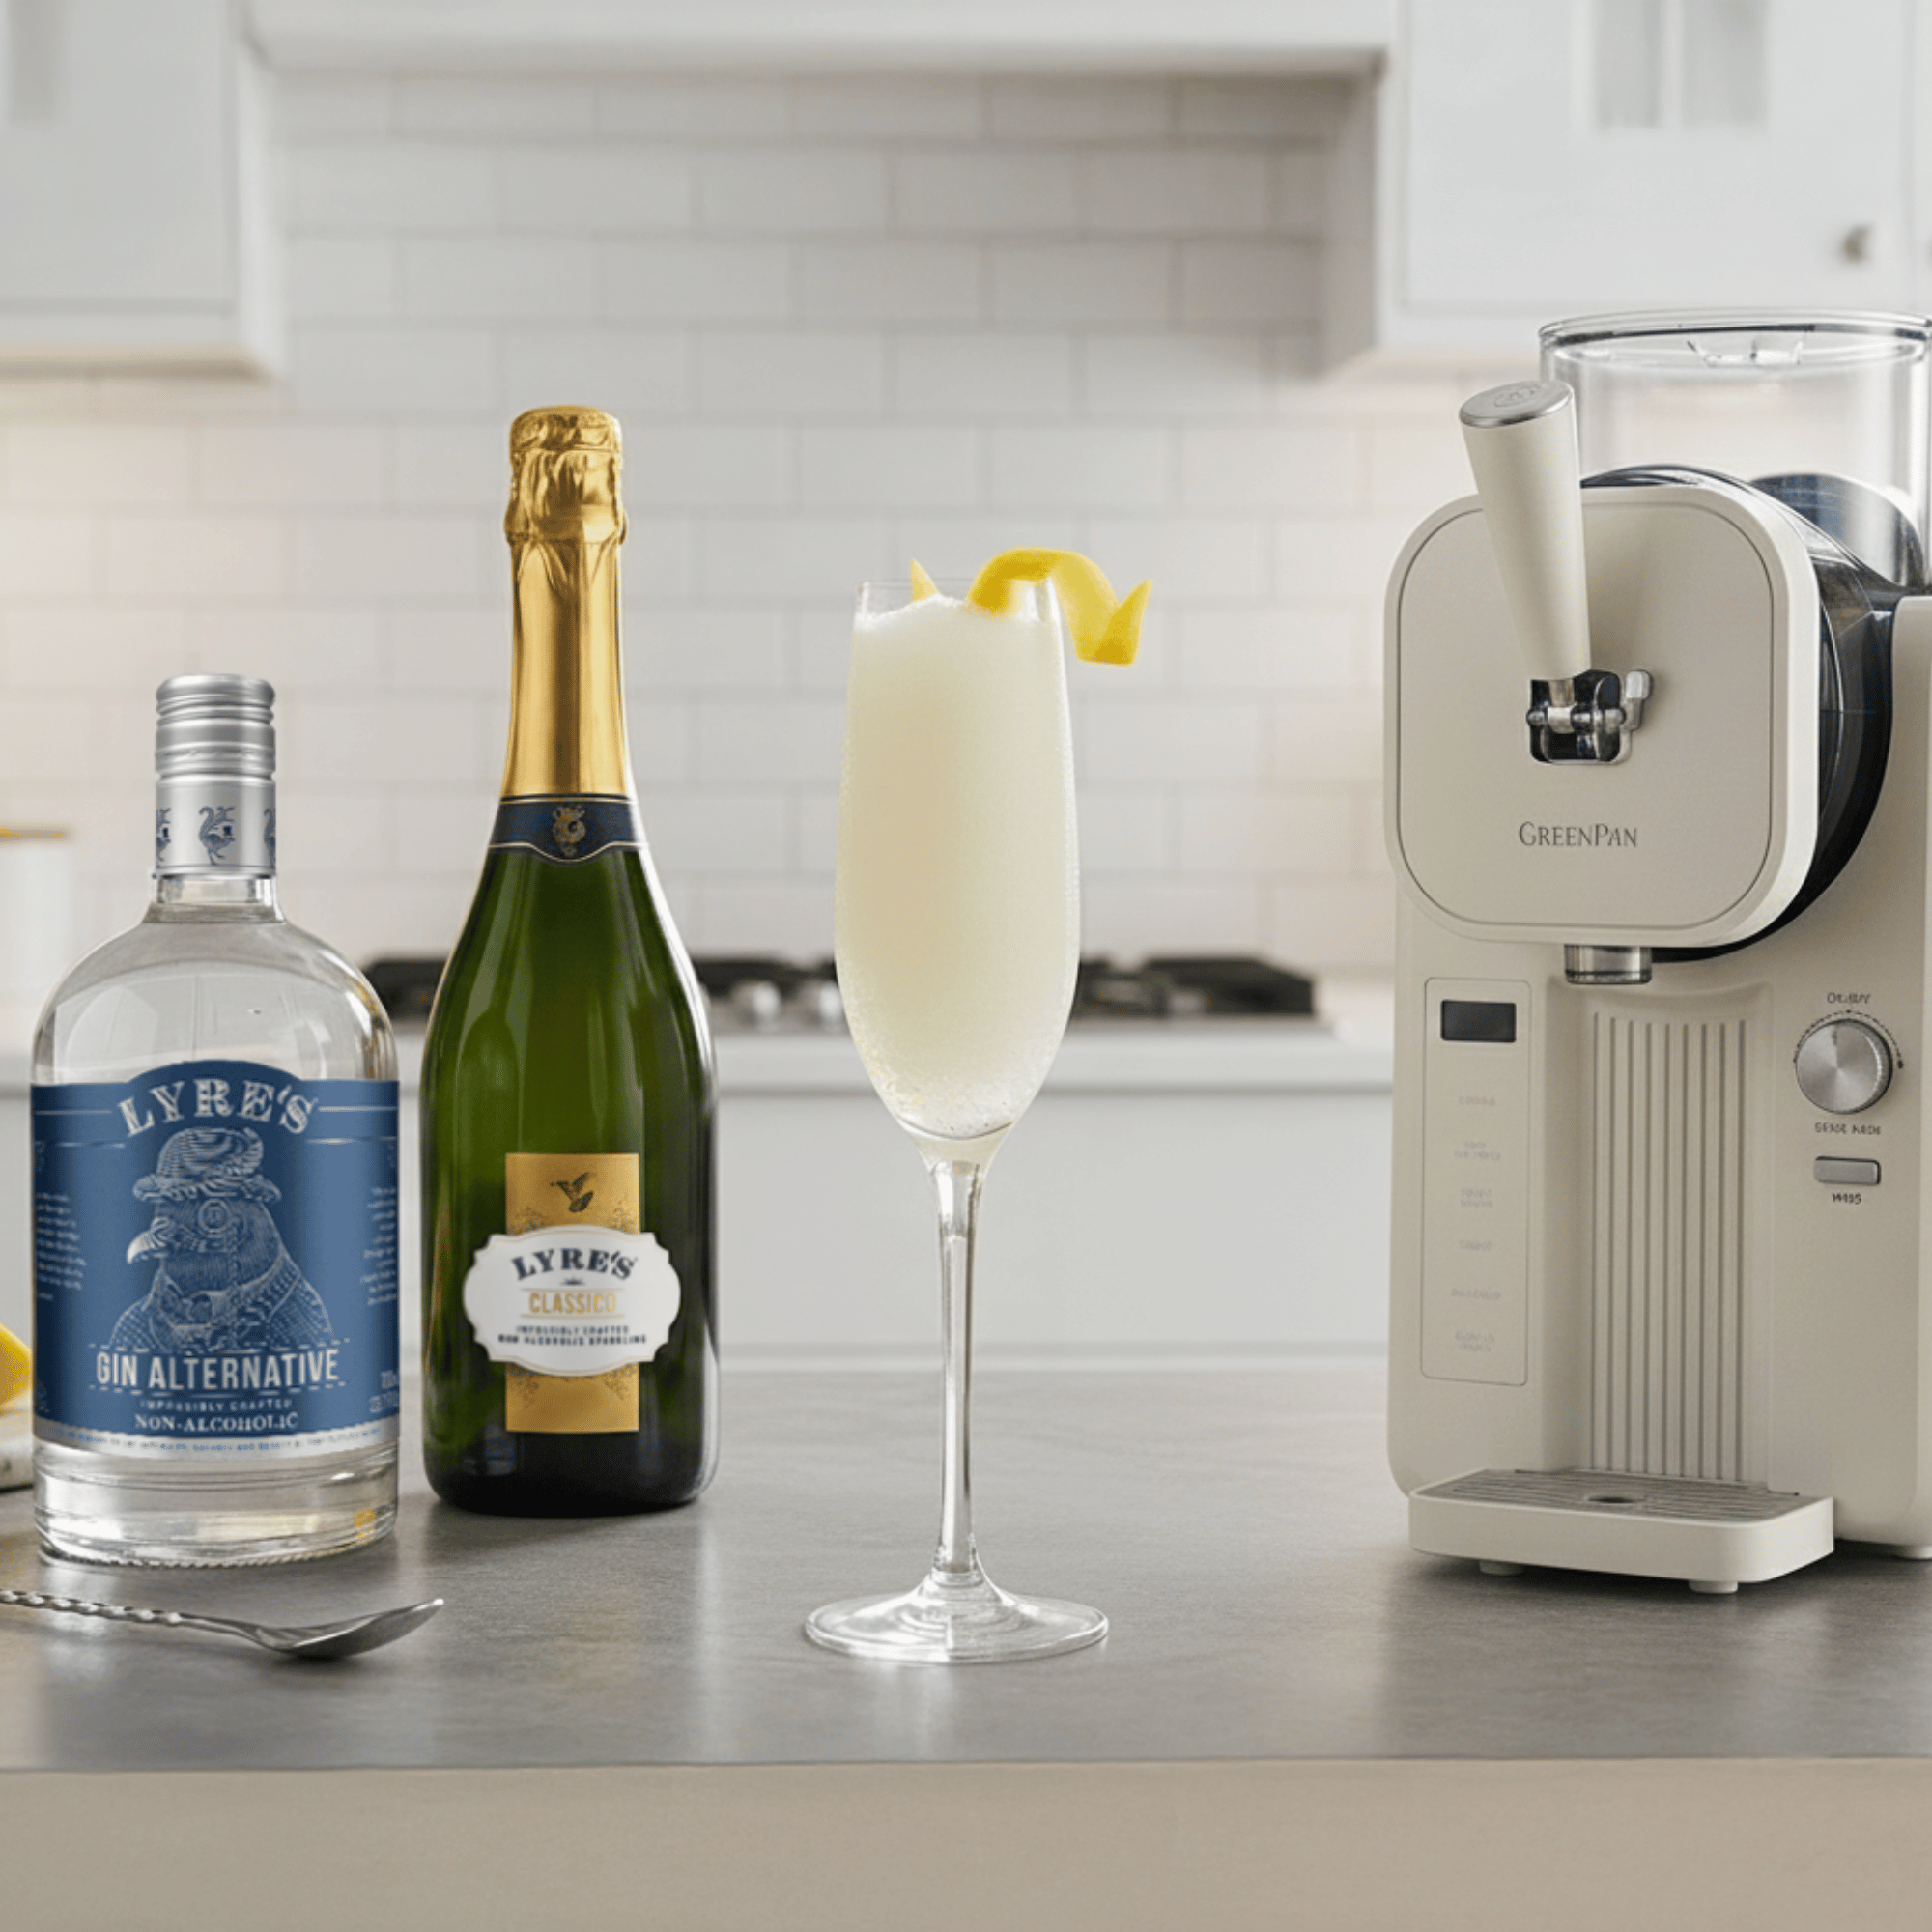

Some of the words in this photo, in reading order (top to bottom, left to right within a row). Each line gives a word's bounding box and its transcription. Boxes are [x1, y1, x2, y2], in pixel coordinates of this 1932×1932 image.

[118, 1077, 316, 1137] LYRE'S
[511, 1247, 635, 1281] LYRE'S
[528, 1292, 617, 1315] CLASSICO
[97, 1352, 138, 1387] GIN
[149, 1349, 340, 1391] ALTERNATIVE
[134, 1410, 299, 1433] NON-ALCOHOLIC
